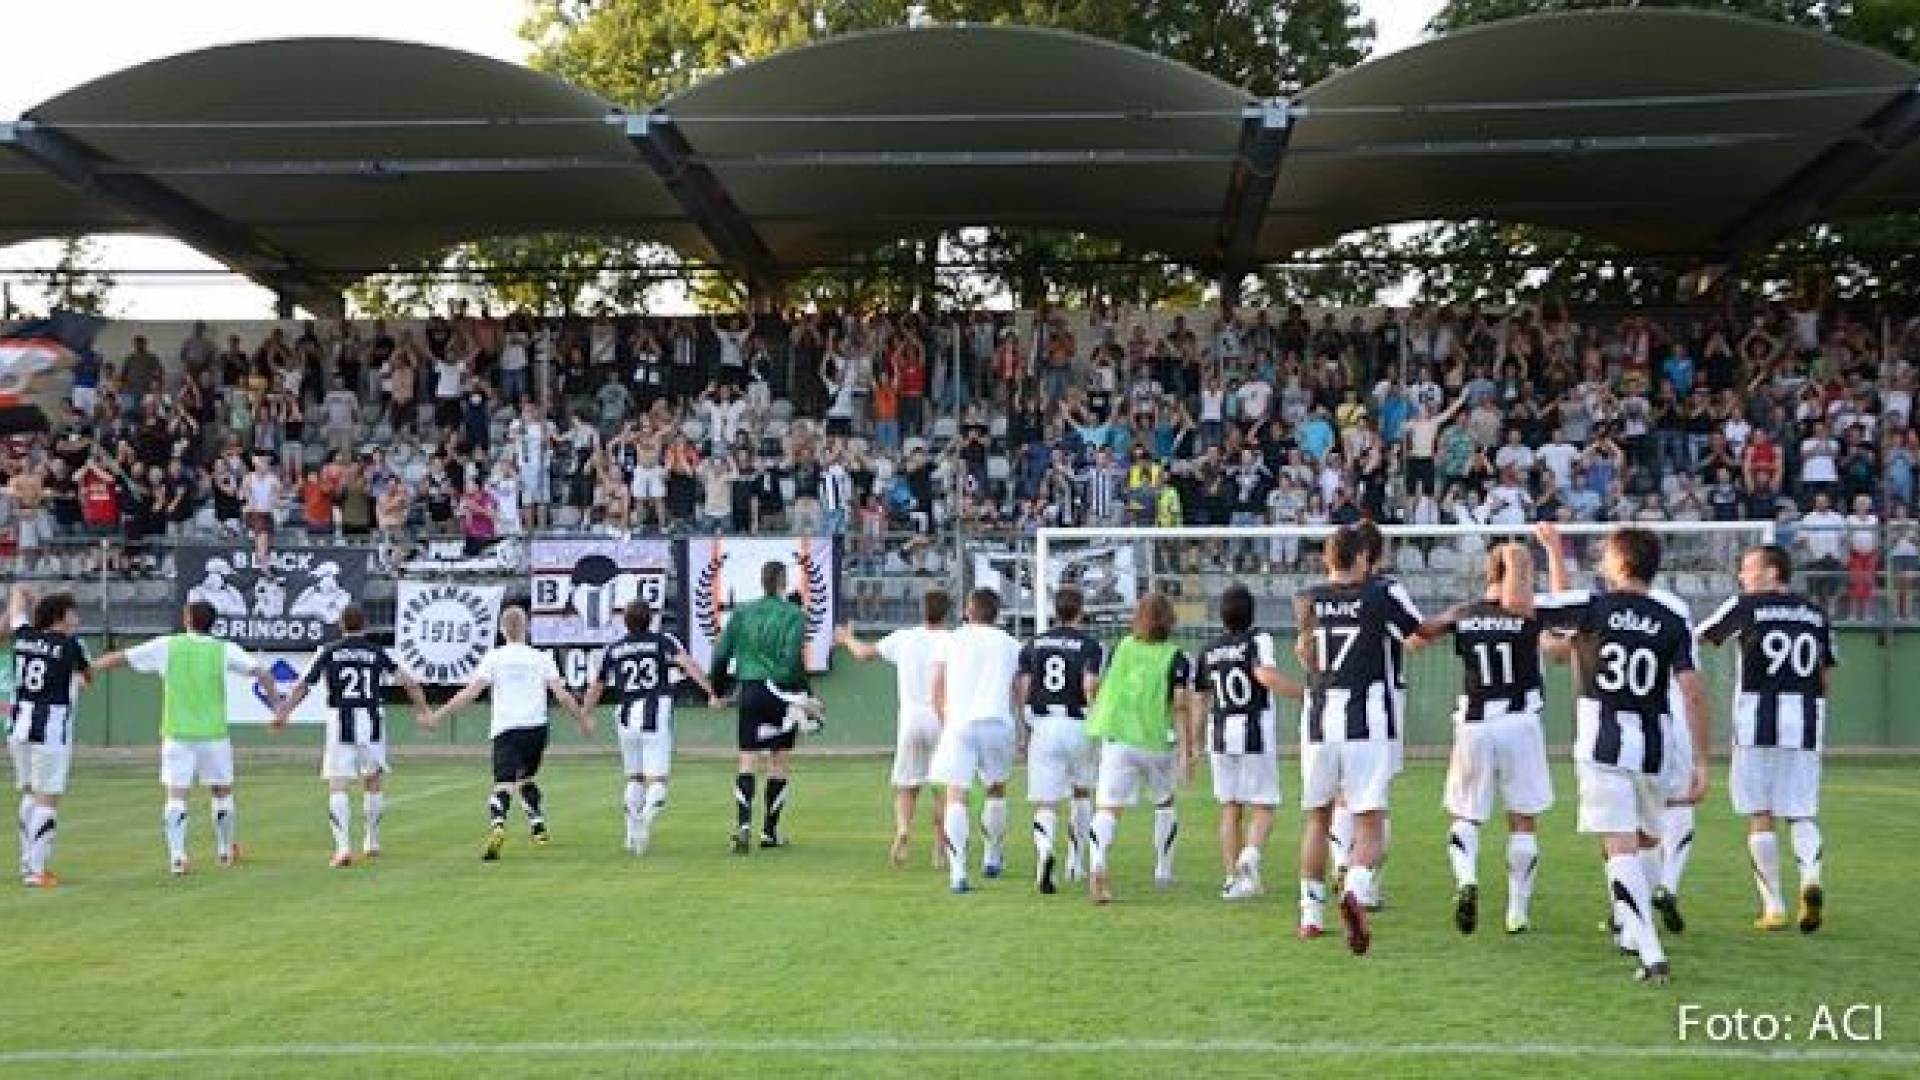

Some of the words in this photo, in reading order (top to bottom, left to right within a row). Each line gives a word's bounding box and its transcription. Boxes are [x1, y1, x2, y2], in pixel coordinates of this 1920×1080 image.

[537, 579, 557, 605] B
[210, 619, 324, 640] GRINGOS
[421, 619, 470, 643] 1919
[1313, 626, 1361, 671] 17
[1474, 642, 1513, 687] 11
[1762, 630, 1818, 677] 90
[15, 655, 47, 692] 18
[339, 667, 374, 698] 21
[621, 657, 660, 693] 23
[1043, 654, 1066, 692] 8
[1211, 667, 1252, 708] 10
[1596, 642, 1658, 696] 30
